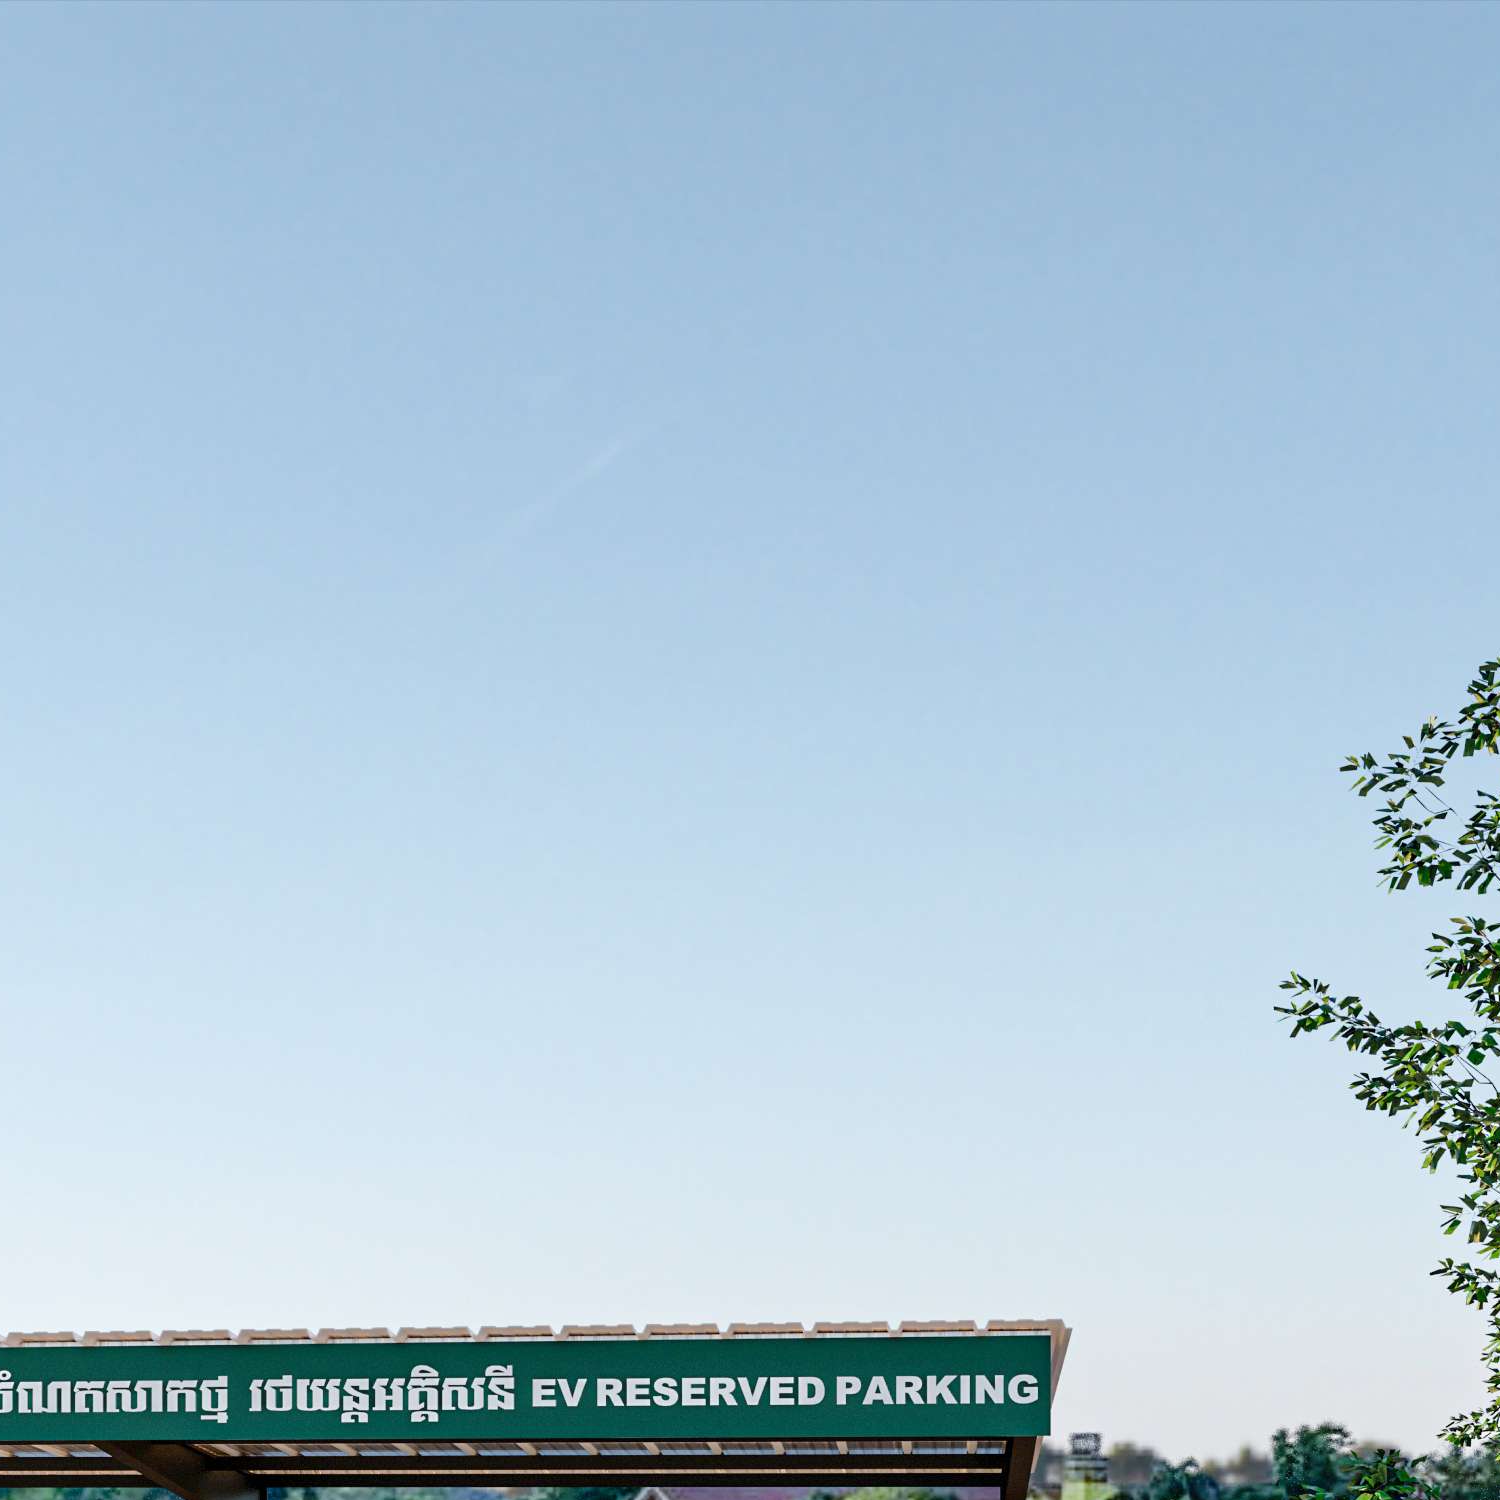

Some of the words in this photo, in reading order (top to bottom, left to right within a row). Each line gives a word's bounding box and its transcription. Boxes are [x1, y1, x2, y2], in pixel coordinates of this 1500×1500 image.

[532, 1378, 588, 1408] EV
[596, 1376, 826, 1407] RESERVED
[836, 1373, 1039, 1406] PARKING
